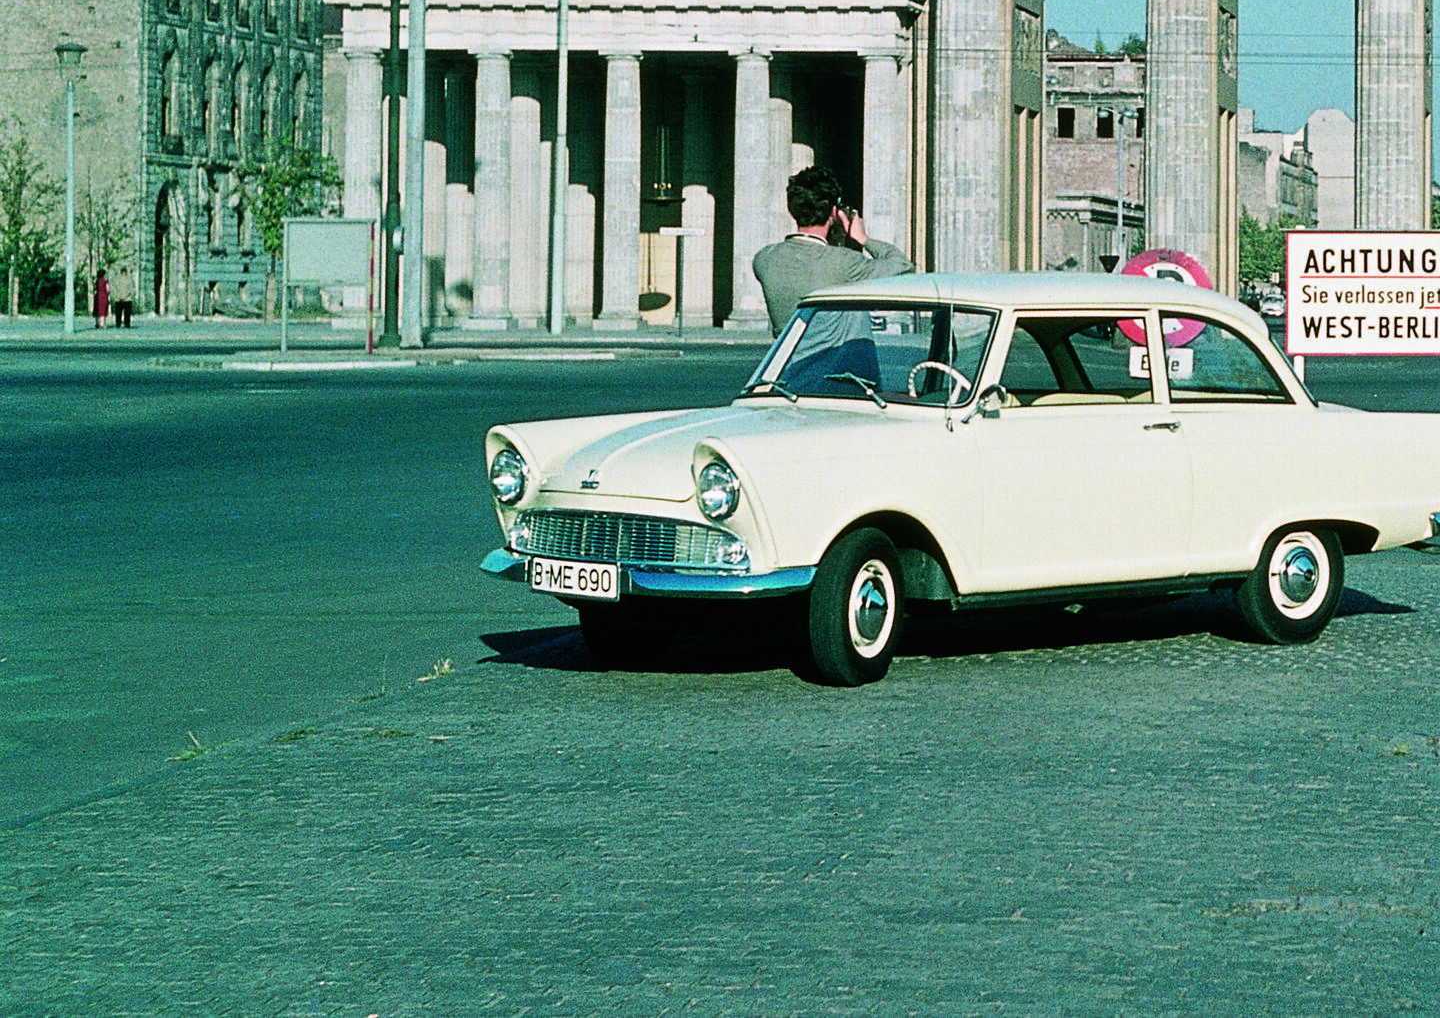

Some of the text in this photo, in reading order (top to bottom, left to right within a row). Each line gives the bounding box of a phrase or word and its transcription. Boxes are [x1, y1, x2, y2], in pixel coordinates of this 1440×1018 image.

[1302, 284, 1329, 304] Sie
[1335, 284, 1415, 304] verlassen
[1141, 354, 1180, 372] Ee
[578, 568, 612, 593] 690
